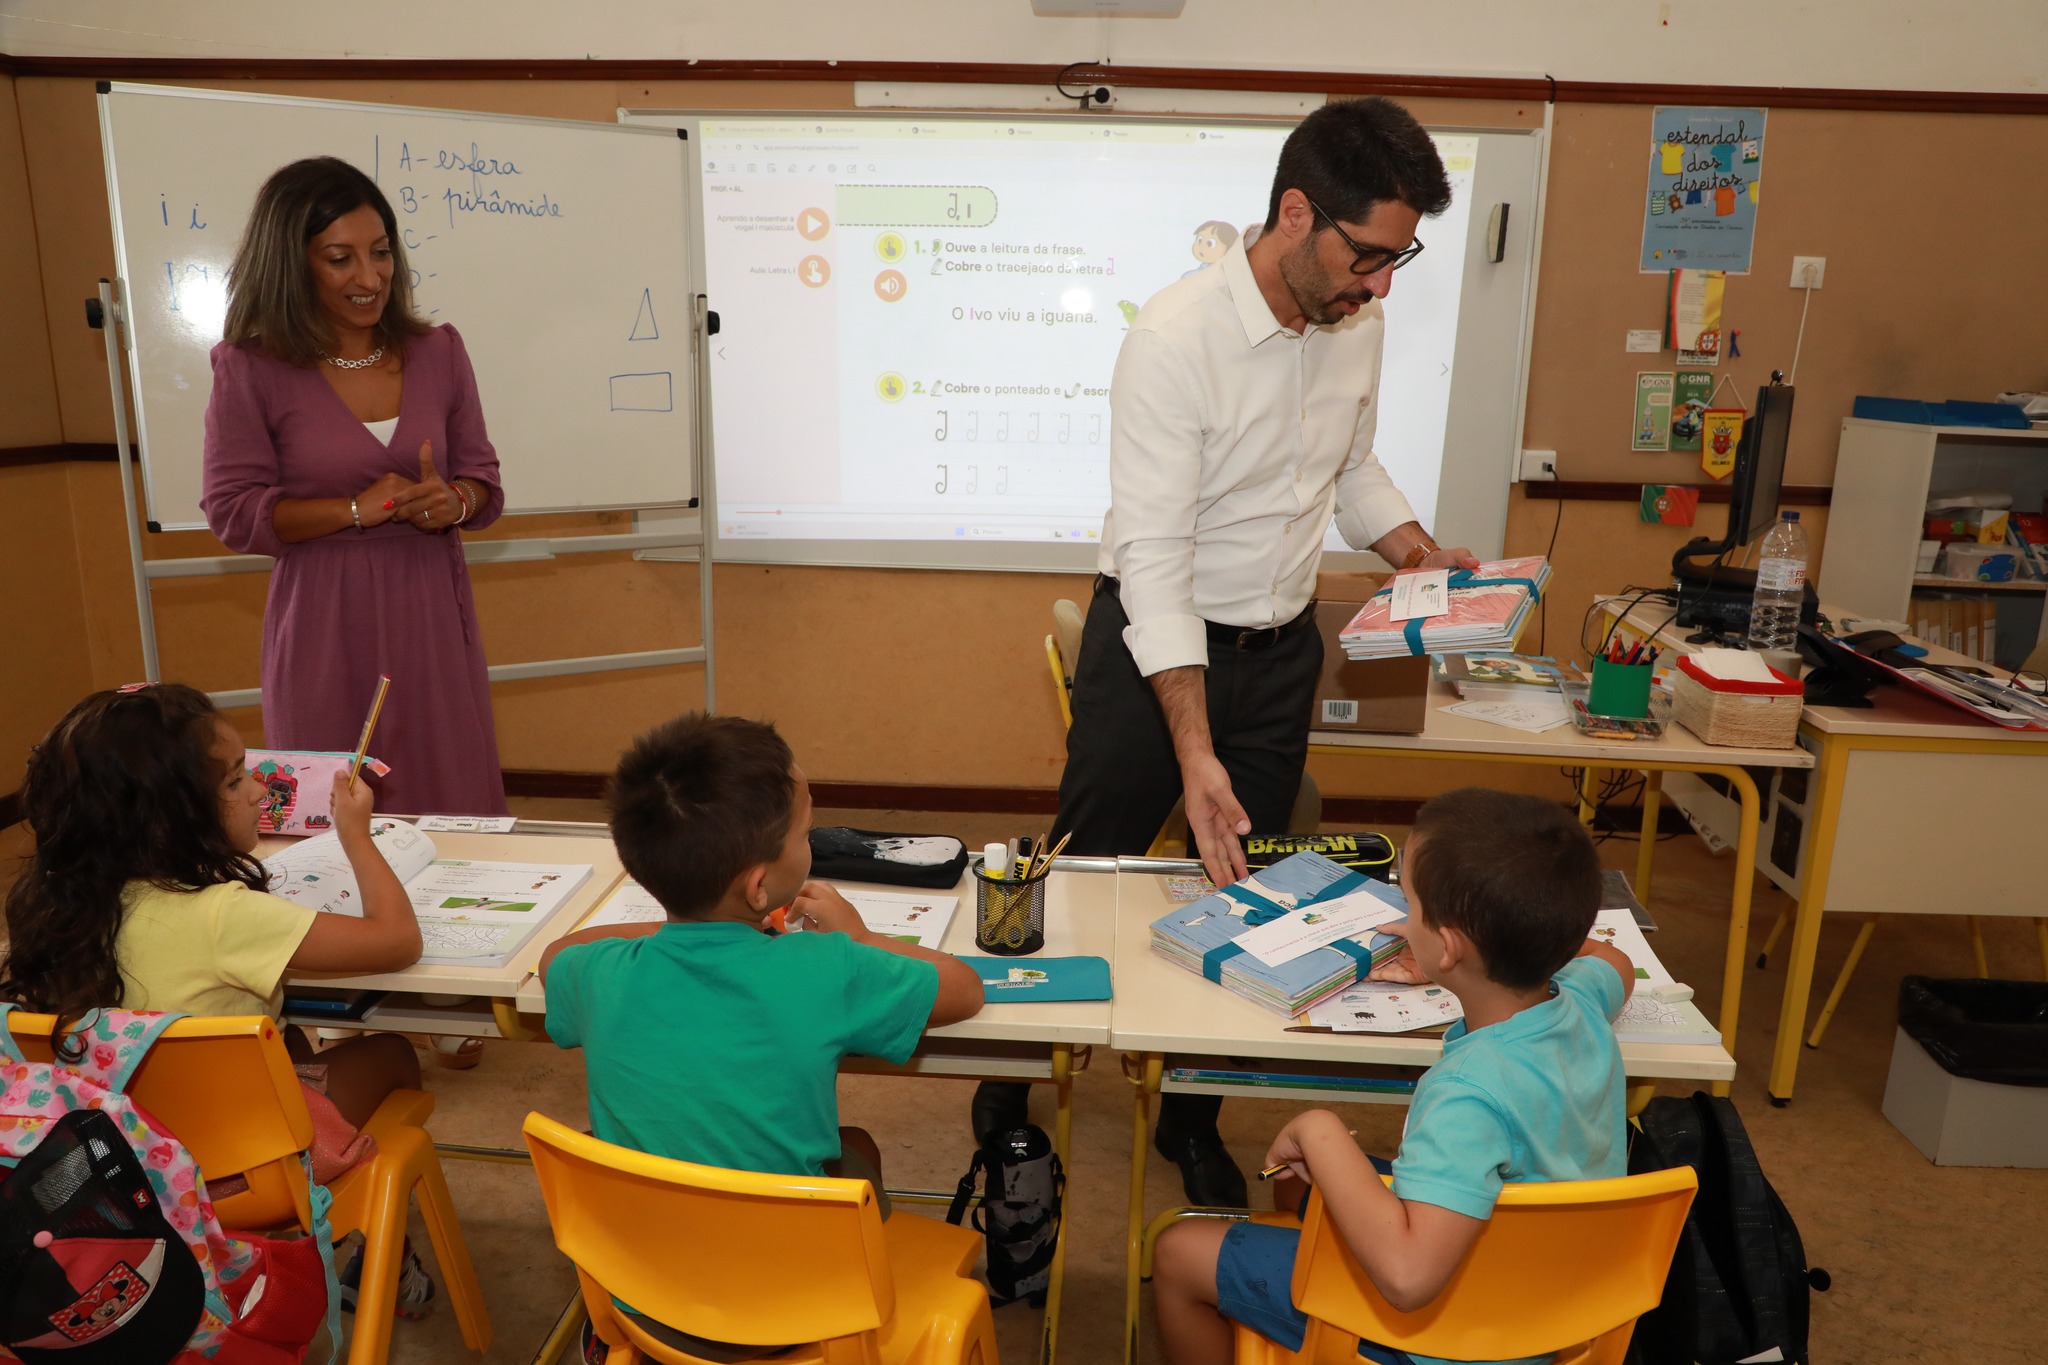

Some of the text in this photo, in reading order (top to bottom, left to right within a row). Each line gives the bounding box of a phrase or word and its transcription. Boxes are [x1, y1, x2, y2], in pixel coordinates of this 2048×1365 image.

[1667, 120, 1748, 145] estendal
[1686, 152, 1723, 172] dos
[434, 142, 523, 202] esfera
[1672, 171, 1742, 192] direitos
[443, 188, 563, 229] pirâmide
[717, 215, 748, 224] Aprendo
[755, 215, 789, 223] desenhar
[734, 224, 754, 232] vogal
[759, 223, 795, 231] maiúscula
[945, 242, 976, 253] Ouve
[980, 244, 987, 253] a
[991, 243, 1029, 254] leitura
[1034, 243, 1048, 254] da
[1053, 243, 1086, 256] frase.
[945, 261, 982, 272] Cobre
[985, 264, 993, 272] o
[997, 262, 1054, 276] tracejado
[952, 307, 1098, 326] O Ivo viu a iguana.
[1688, 375, 1711, 384] GNR
[912, 381, 926, 394] 2.
[945, 383, 980, 393] Cobre
[983, 386, 991, 394] o
[995, 384, 1050, 396] ponteado
[1054, 387, 1061, 396] e
[307, 815, 331, 825] LOL
